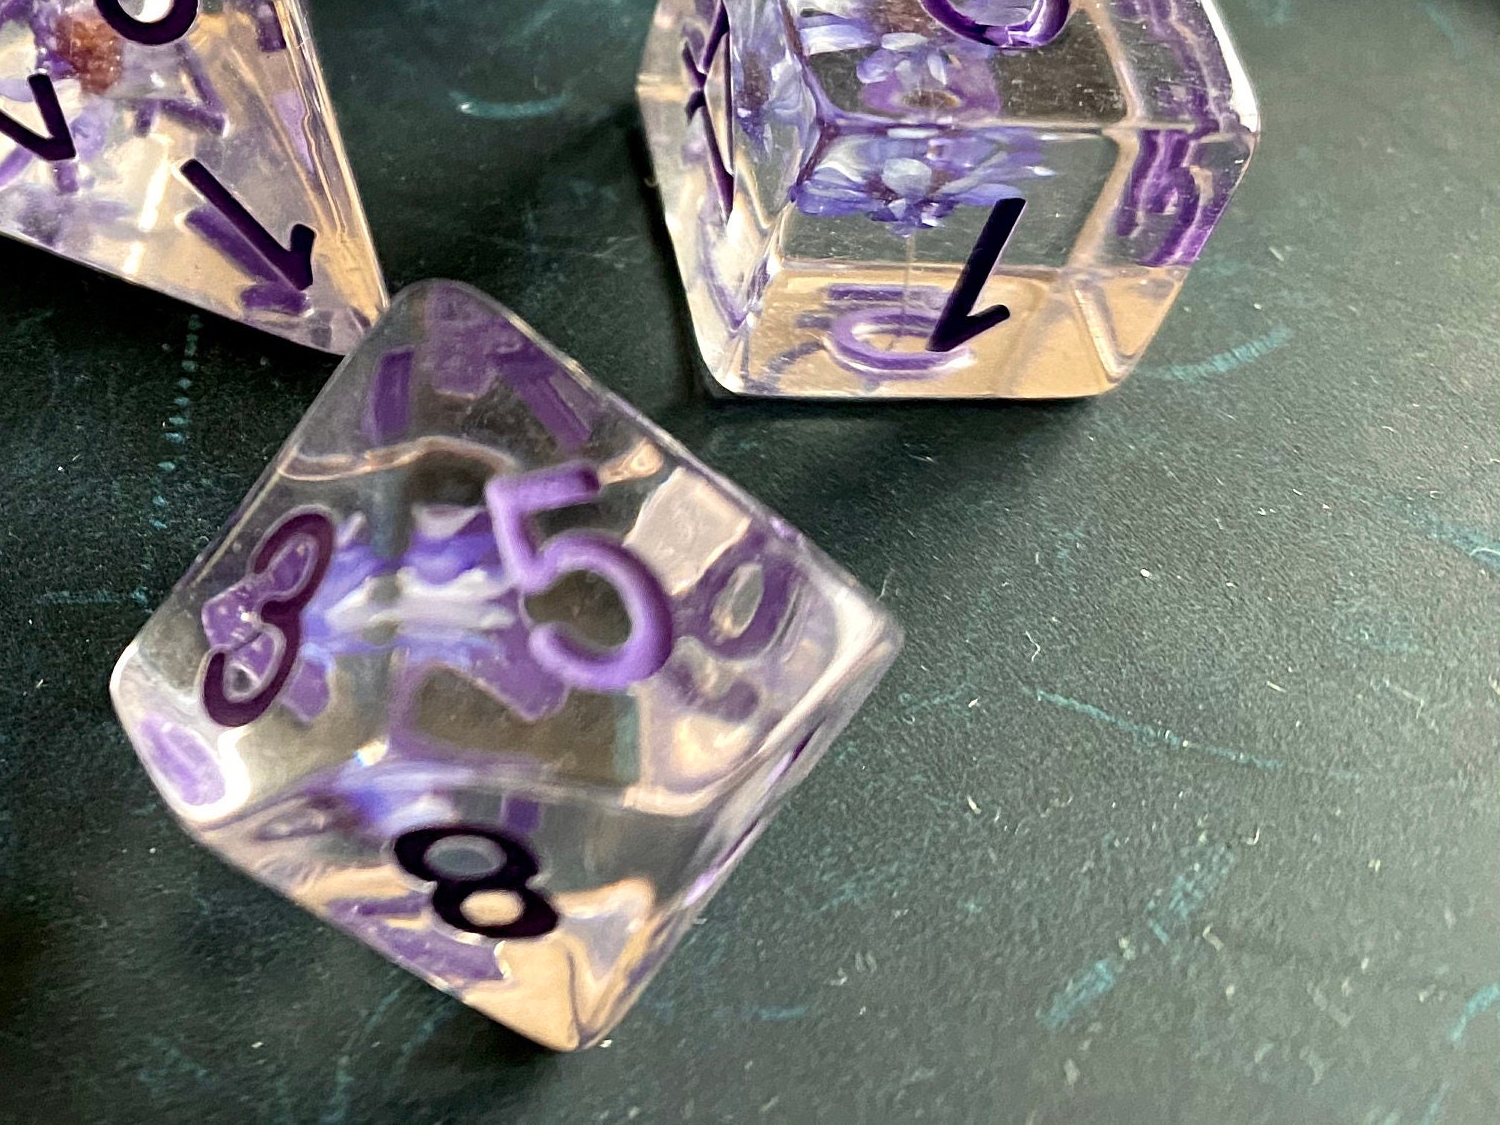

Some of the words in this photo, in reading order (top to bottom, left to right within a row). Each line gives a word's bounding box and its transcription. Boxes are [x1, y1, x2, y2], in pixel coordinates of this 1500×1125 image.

[180, 157, 318, 292] 1
[924, 197, 1027, 353] 1
[201, 509, 337, 728] 3
[484, 459, 674, 690] 5
[392, 824, 560, 941] 8
